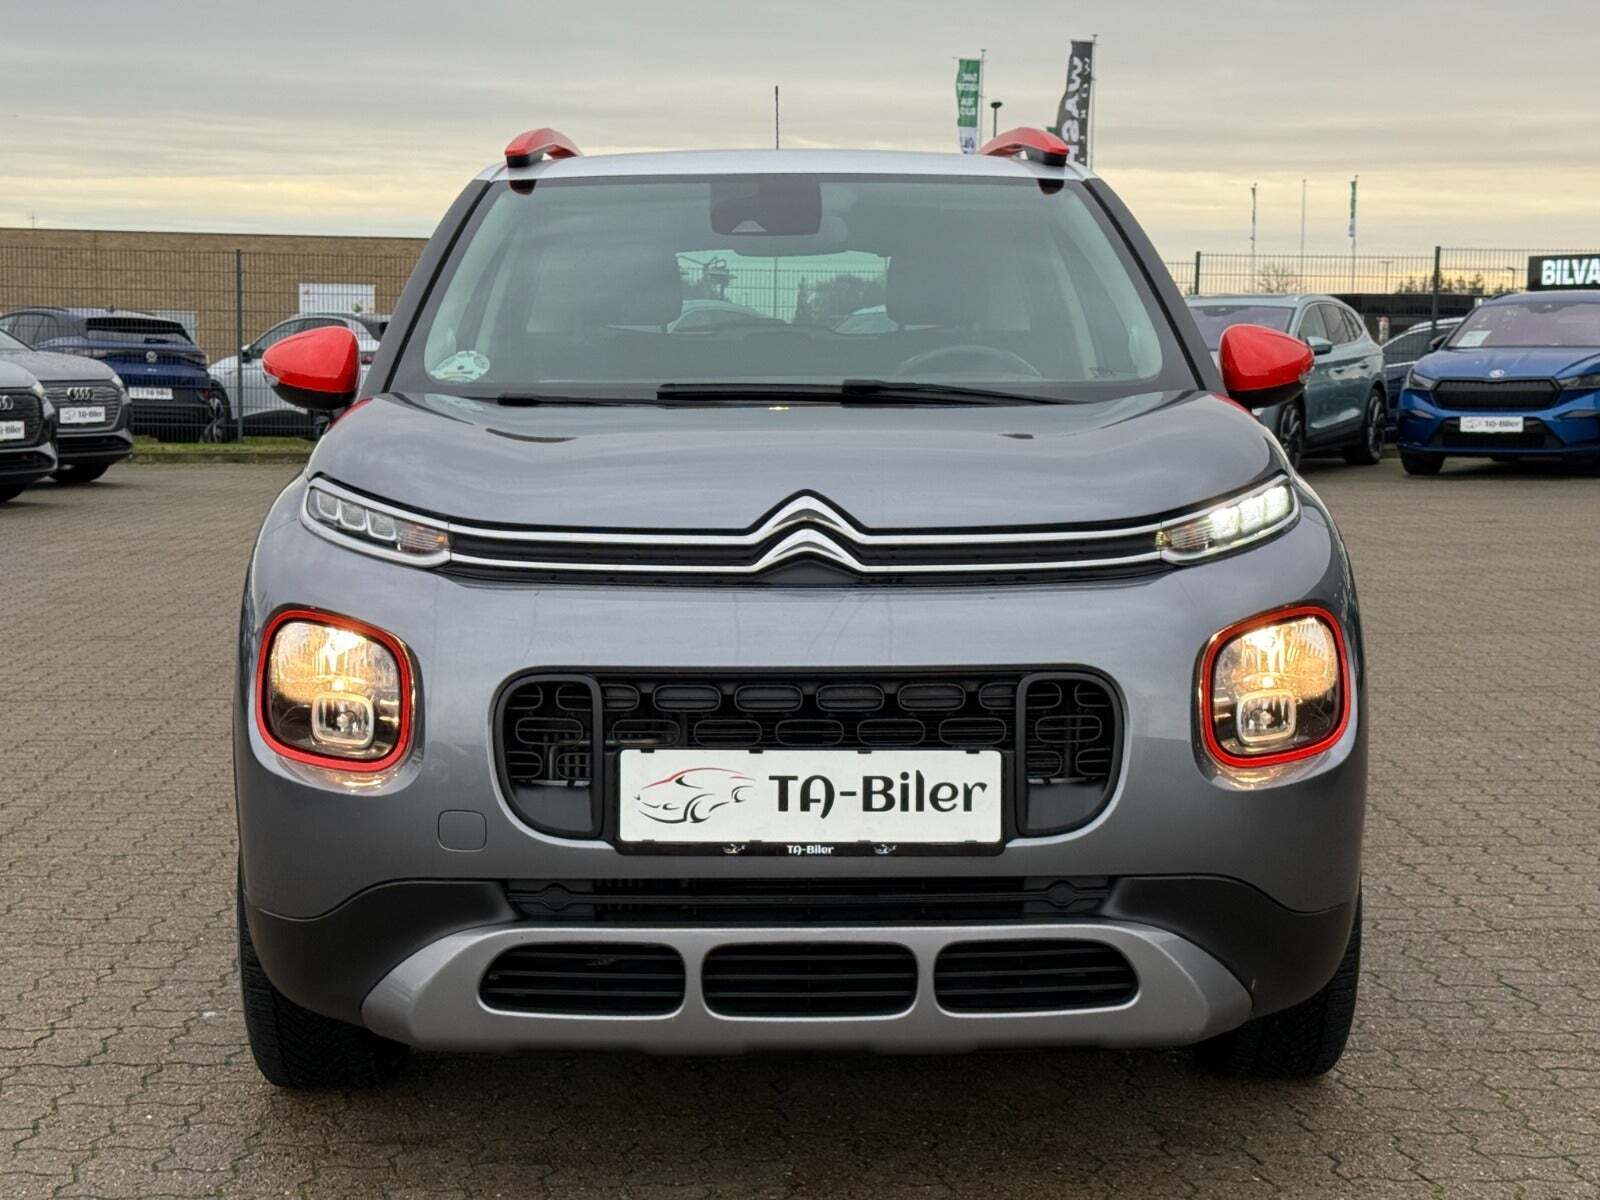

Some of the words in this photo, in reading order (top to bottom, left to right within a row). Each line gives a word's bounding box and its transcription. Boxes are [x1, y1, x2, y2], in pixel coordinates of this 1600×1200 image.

[1541, 258, 1600, 286] BILVA
[768, 770, 987, 819] TA-Biler
[786, 844, 835, 856] TA-Biler
